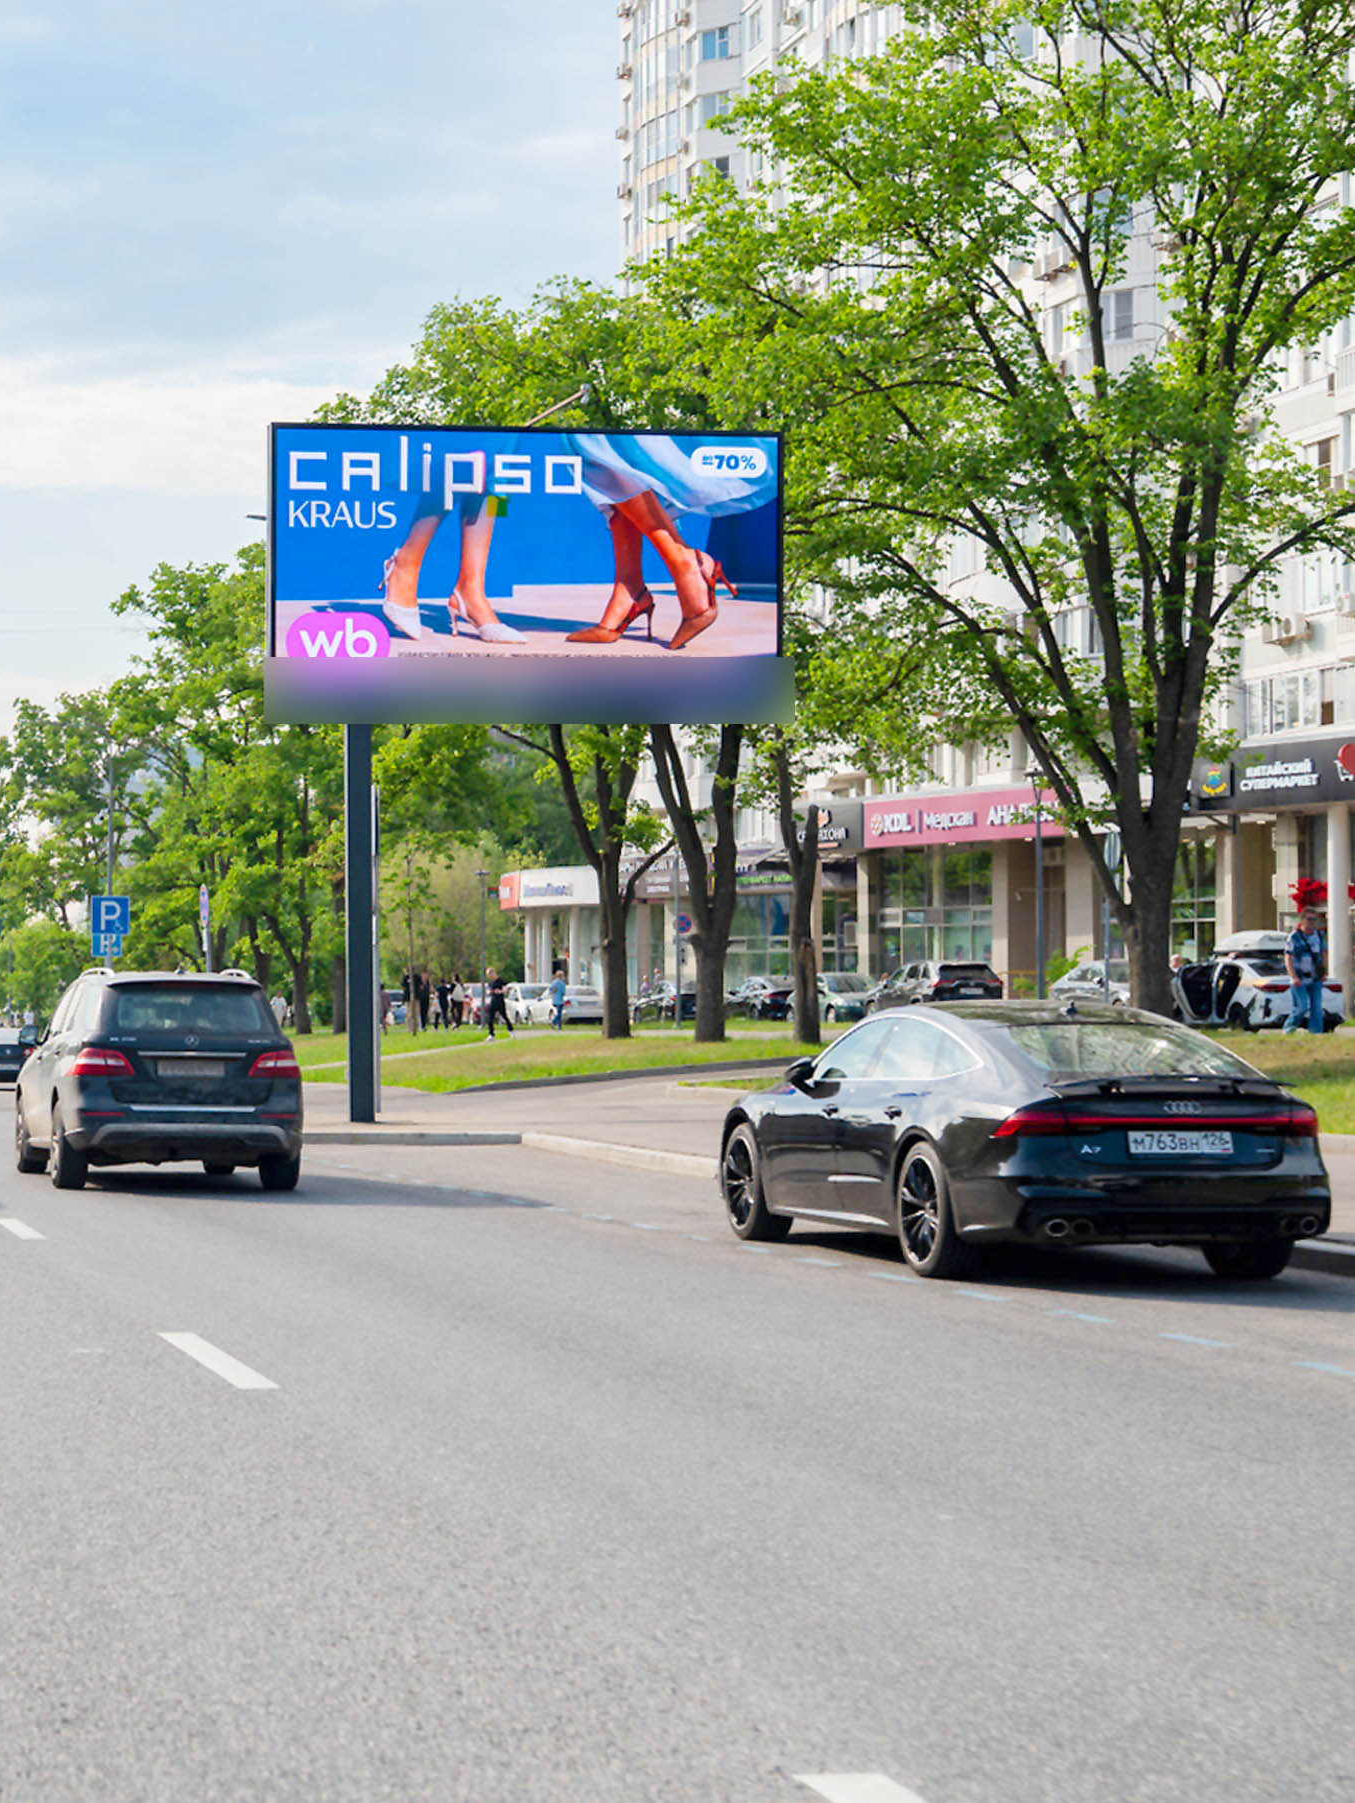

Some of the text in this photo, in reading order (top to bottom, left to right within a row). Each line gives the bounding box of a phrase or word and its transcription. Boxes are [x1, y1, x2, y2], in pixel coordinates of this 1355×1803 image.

[288, 500, 397, 529] KRAUS
[884, 813, 913, 833] KDL
[923, 811, 975, 832] Медскан
[101, 901, 121, 930] P
